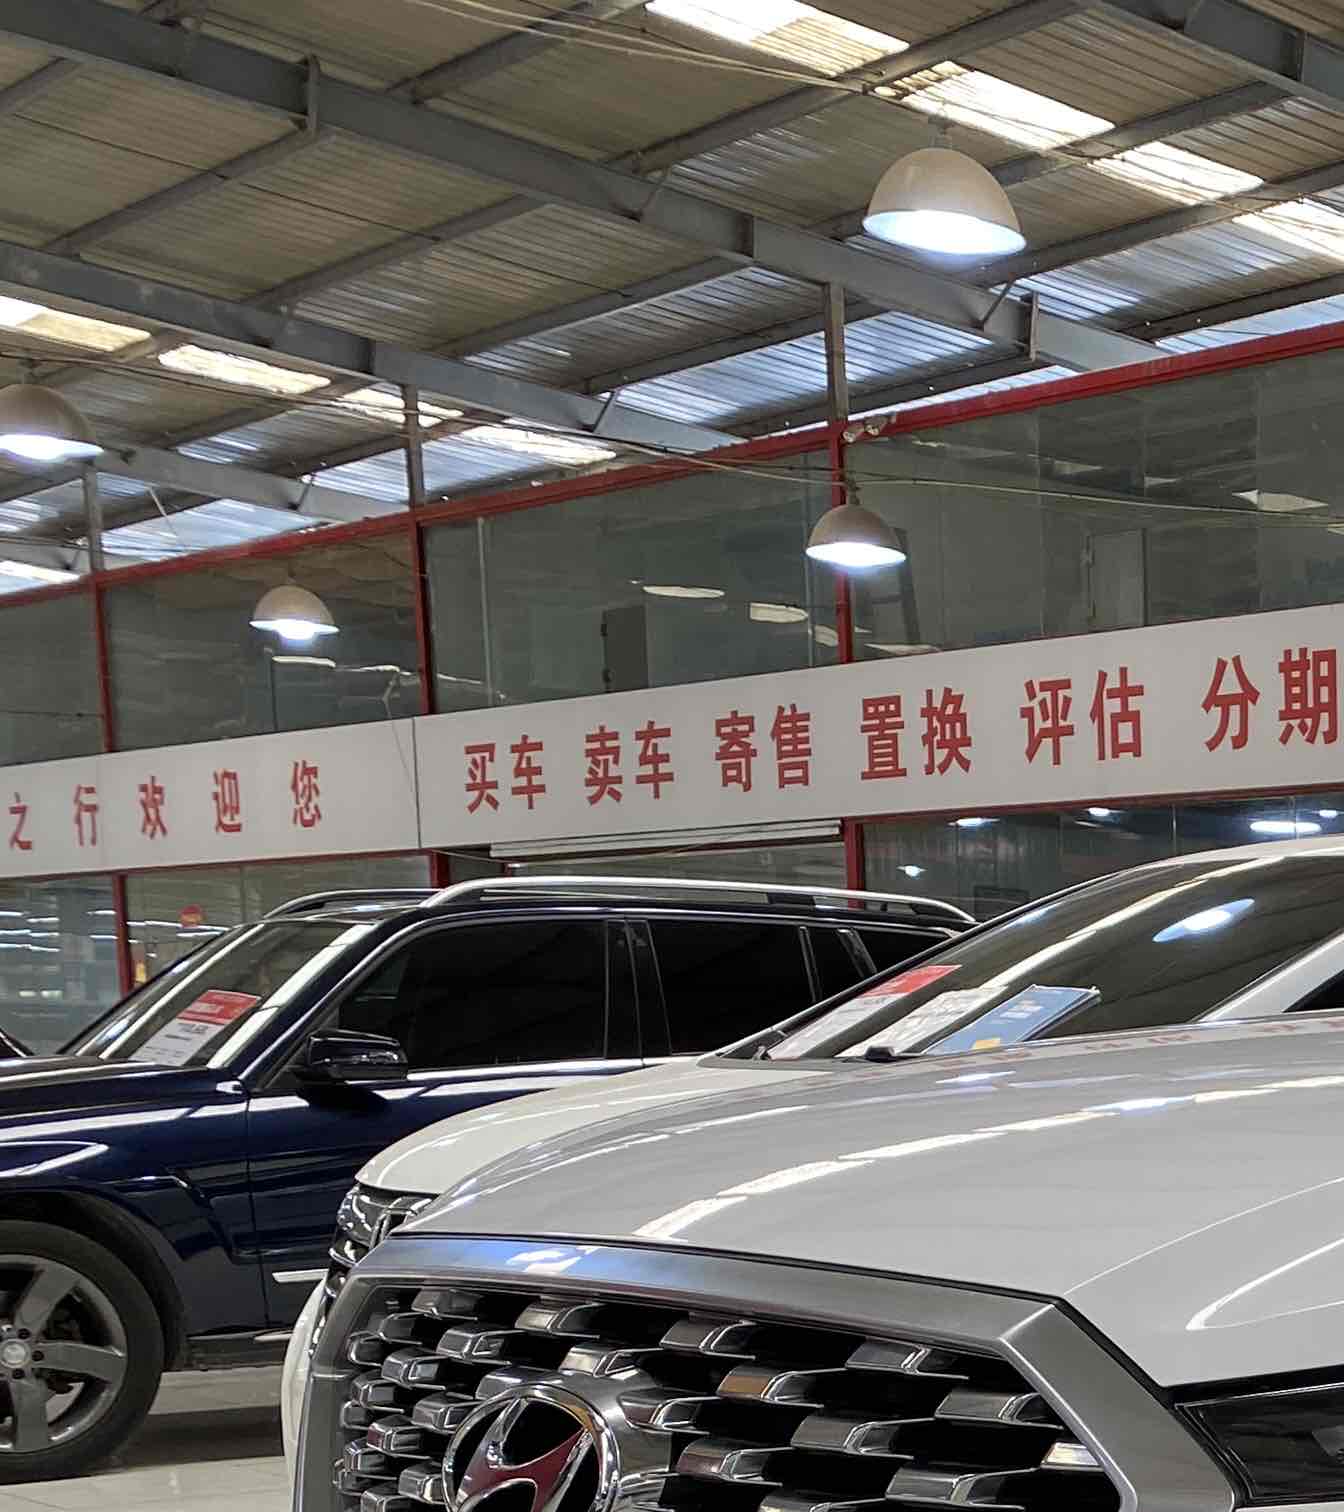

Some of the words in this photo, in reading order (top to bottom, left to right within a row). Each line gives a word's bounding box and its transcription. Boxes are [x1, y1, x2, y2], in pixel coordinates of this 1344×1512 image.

[464, 735, 547, 812] 买车
[585, 721, 674, 804] 卖车
[715, 705, 812, 791] 寄售
[860, 686, 972, 781] 置换
[1020, 667, 1145, 766] 评估
[1202, 646, 1339, 752] 分期
[9, 760, 322, 850] 之行欢迎您
